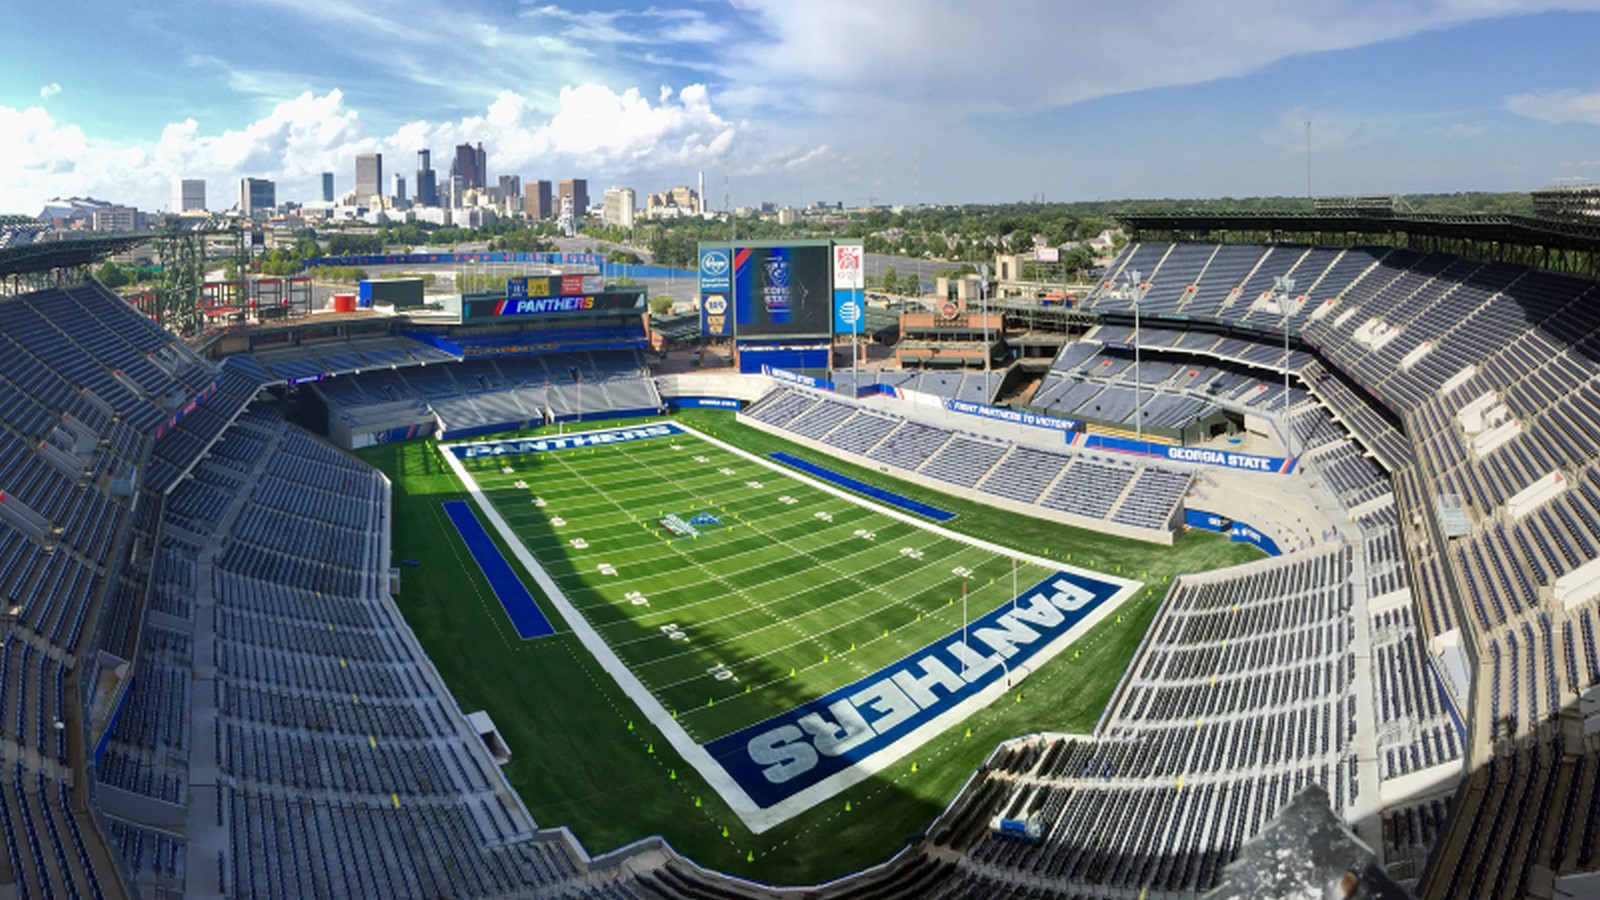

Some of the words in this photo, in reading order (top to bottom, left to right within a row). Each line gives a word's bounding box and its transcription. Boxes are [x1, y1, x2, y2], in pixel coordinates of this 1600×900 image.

[517, 296, 595, 313] PANTHERS
[466, 426, 671, 457] PANTHERS
[1168, 447, 1226, 465] GEORGIA
[1227, 455, 1271, 470] STATE
[747, 579, 1097, 784] PANTHERS
